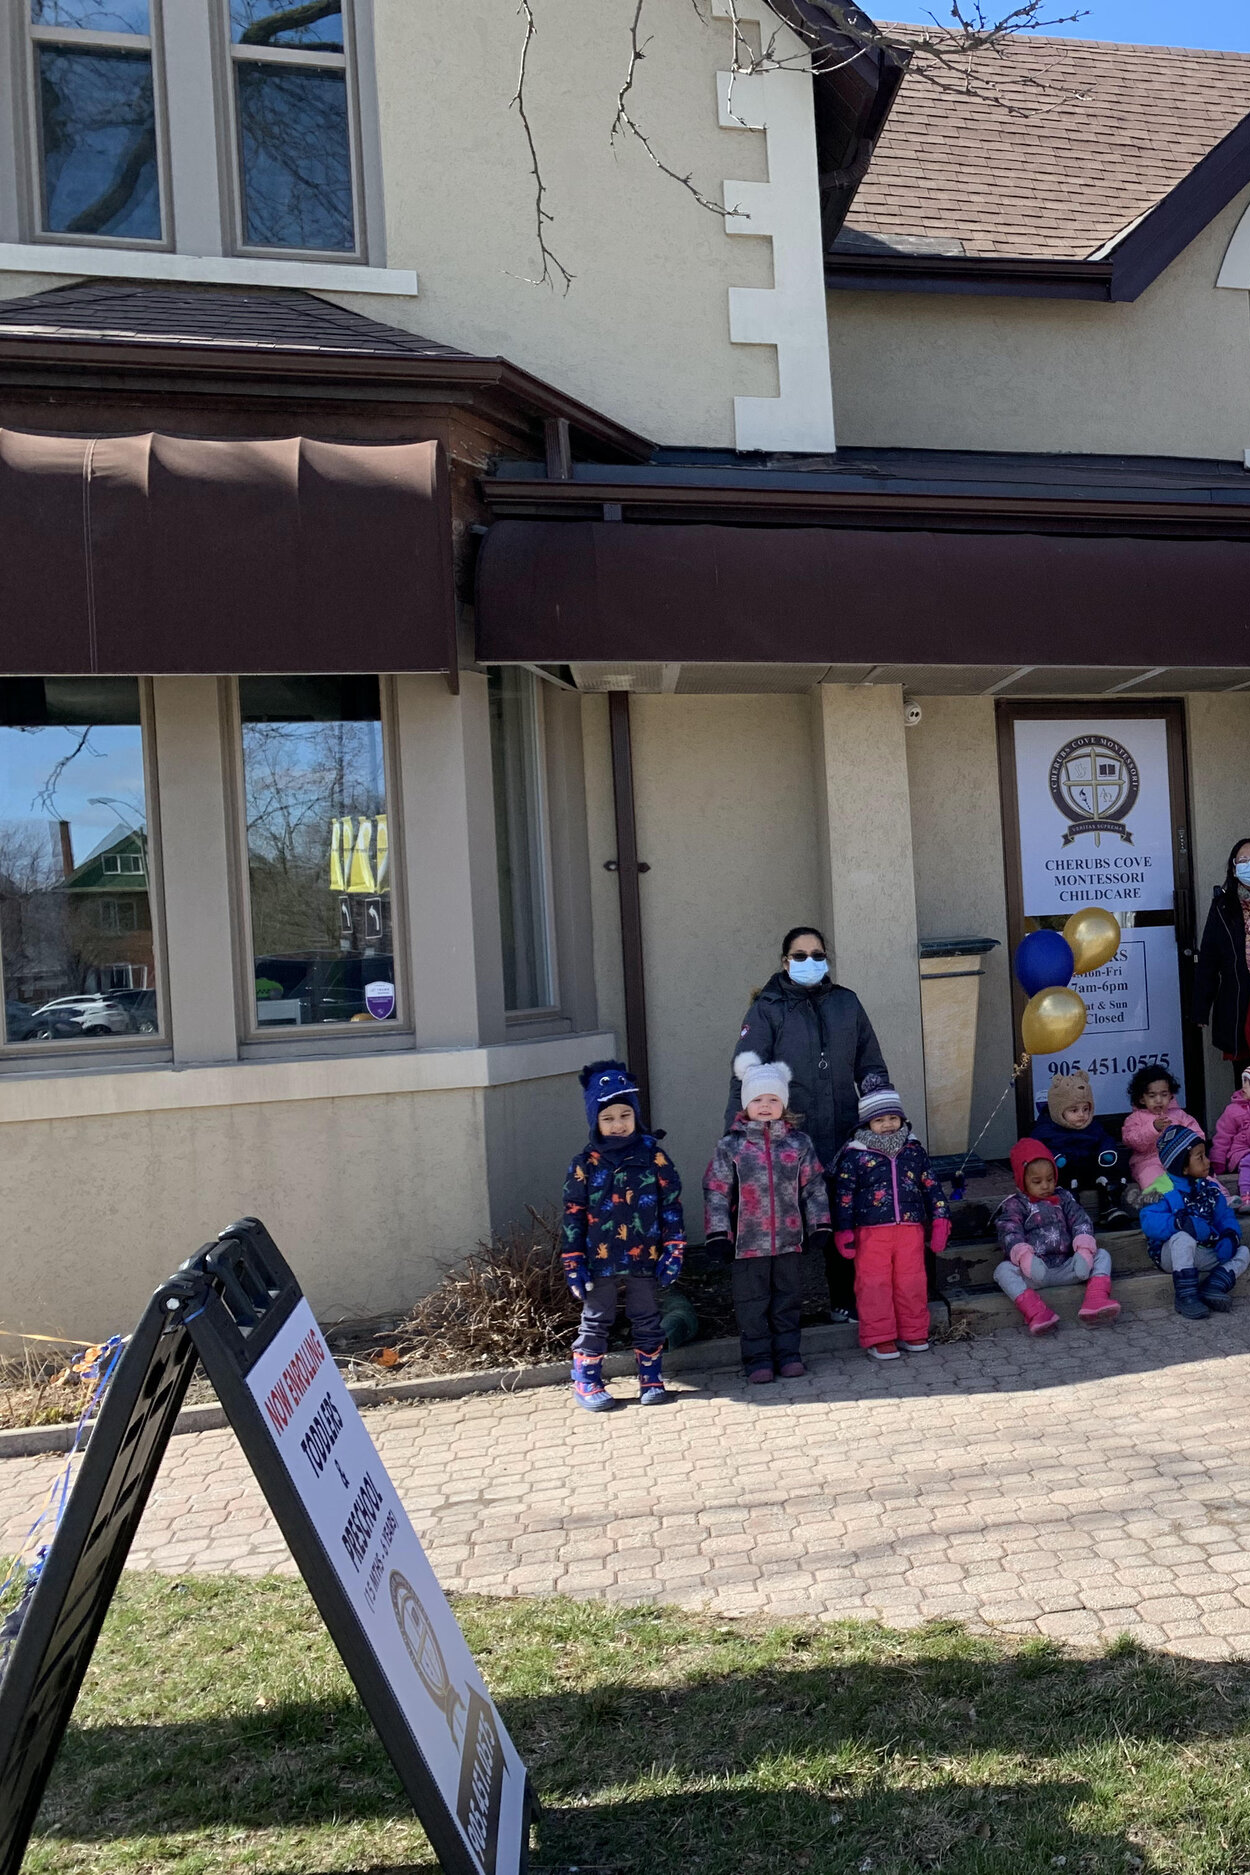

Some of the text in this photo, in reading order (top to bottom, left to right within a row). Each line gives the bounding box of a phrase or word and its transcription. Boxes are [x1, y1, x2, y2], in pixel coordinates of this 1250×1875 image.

[1071, 737, 1096, 748] COVE
[1045, 856, 1152, 871] CHERUBS COVE
[1054, 872, 1144, 886] MONTESSORI
[1059, 887, 1141, 902] CHILDCARE
[1071, 981, 1128, 994] 7am-6pm
[1097, 1002, 1106, 1010] &
[1109, 1000, 1128, 1009] Sun
[1086, 1012, 1125, 1024] Closed
[264, 1328, 325, 1437] NOW ENROLLING
[300, 1391, 343, 1479] TODDLERS
[334, 1459, 350, 1489] &
[342, 1471, 383, 1574] PRESCHOOL
[467, 1709, 495, 1863] 905.451.0575
